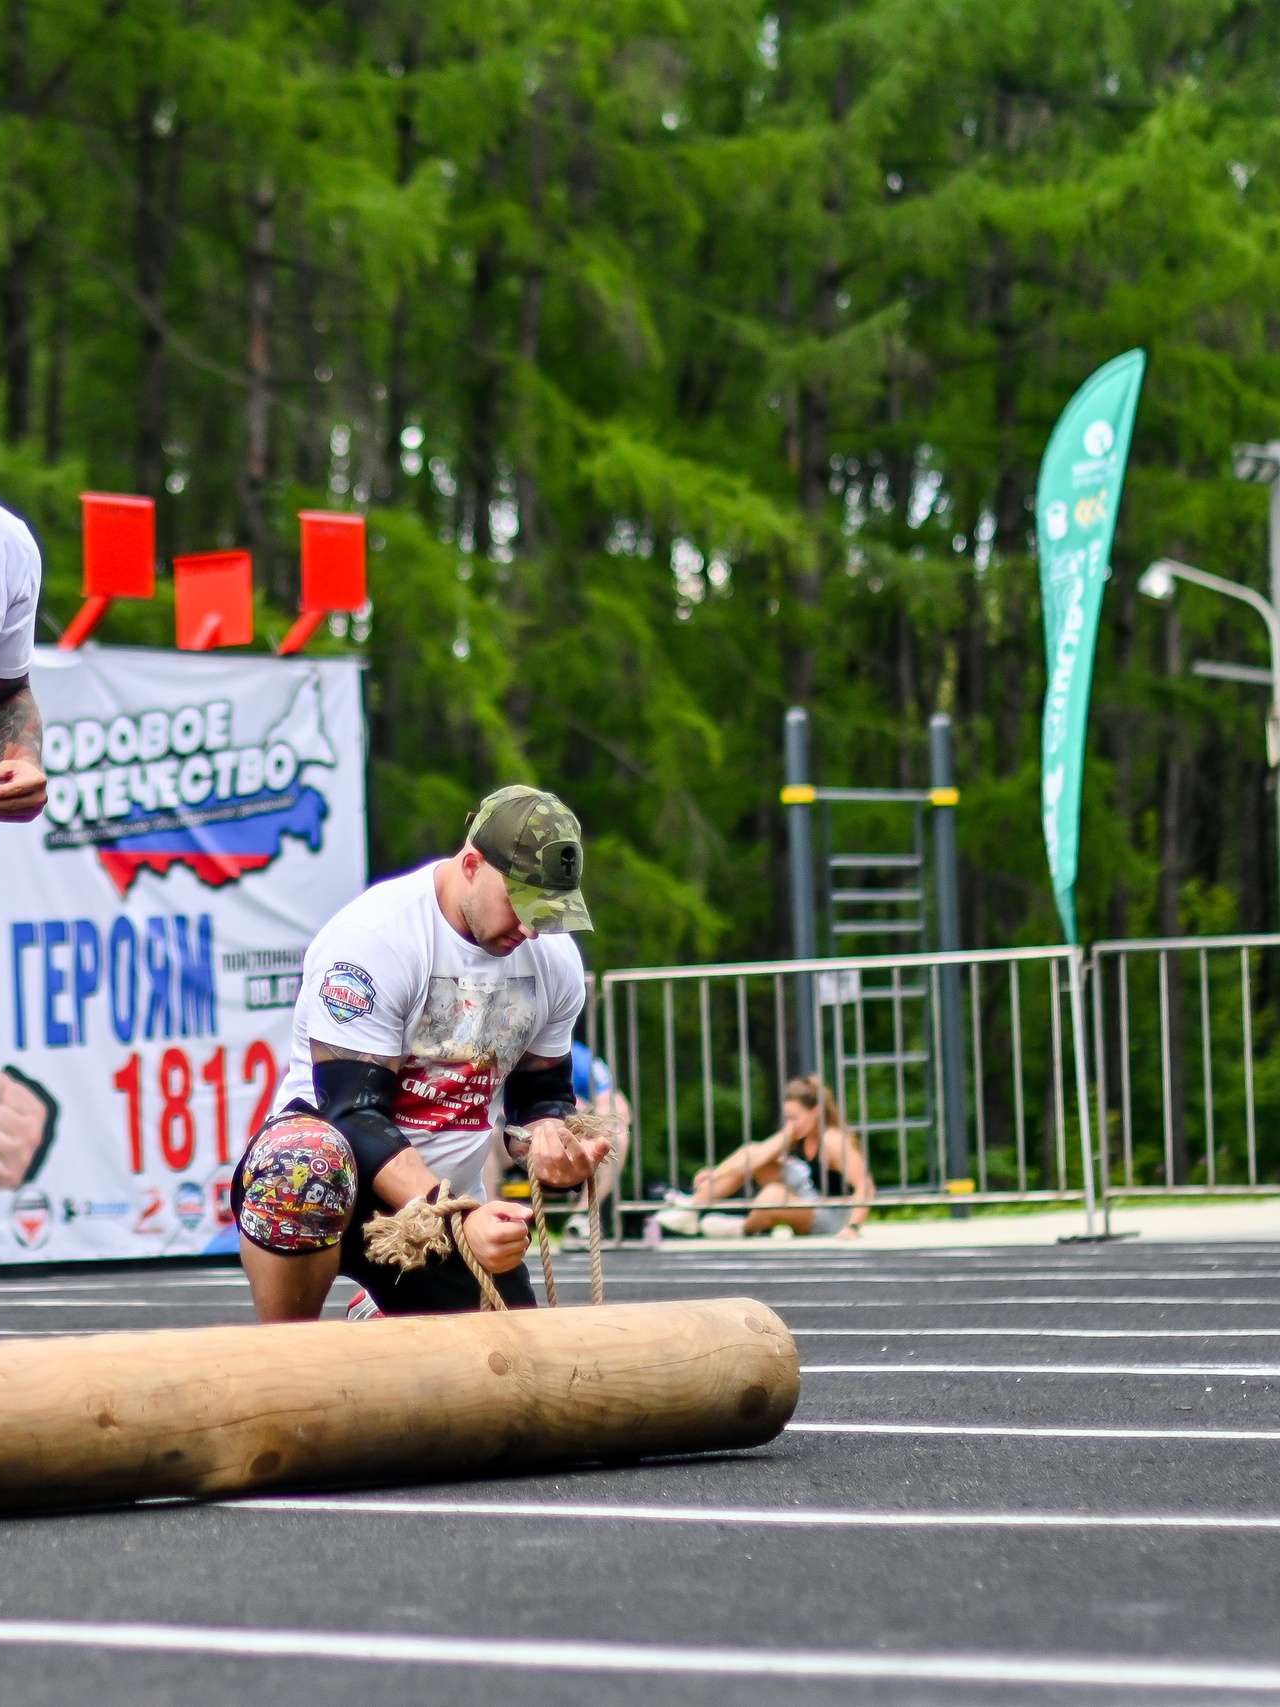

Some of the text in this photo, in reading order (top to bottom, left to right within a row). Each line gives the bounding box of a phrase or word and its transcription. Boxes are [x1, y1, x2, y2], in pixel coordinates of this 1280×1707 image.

[45, 739, 298, 824] ОТЕЧЕСТВО
[10, 913, 219, 1051] ГЕРОЯМ
[112, 1040, 279, 1174] 1812
